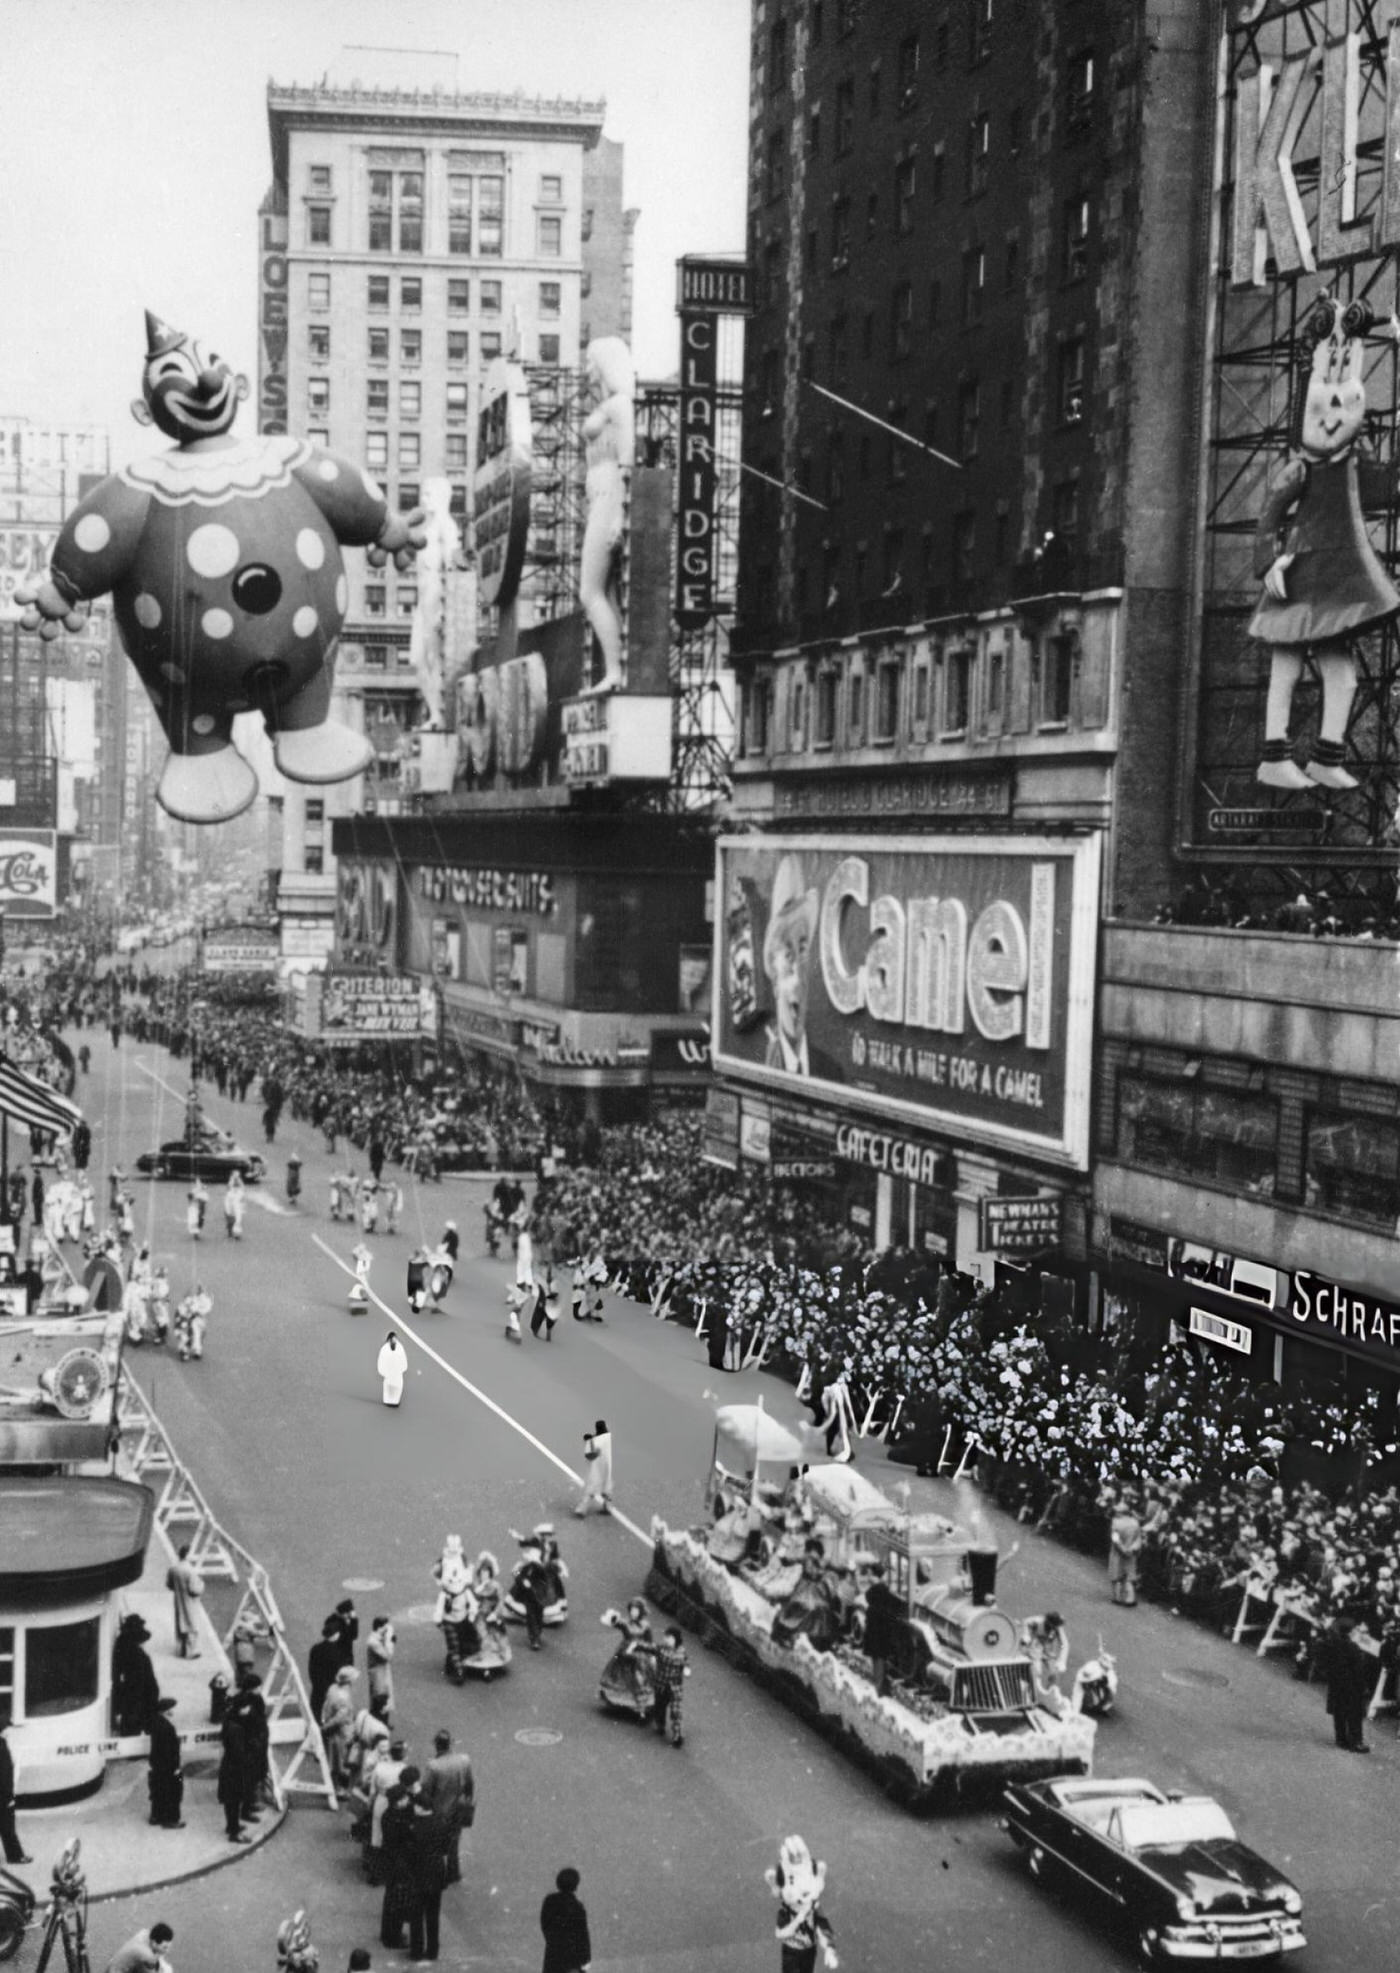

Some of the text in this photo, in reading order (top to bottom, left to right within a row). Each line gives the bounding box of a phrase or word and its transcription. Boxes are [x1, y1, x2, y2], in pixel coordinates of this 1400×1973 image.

[682, 321, 711, 611] CLARIDGE
[819, 856, 1056, 1050] Camel
[330, 976, 413, 994] CRITERION
[903, 1047, 915, 1077] A
[950, 1055, 978, 1094] FOR
[980, 1063, 993, 1098] A
[994, 1065, 1044, 1108] CAMEL
[837, 1124, 938, 1186] CAFETERIA
[57, 1743, 90, 1756] POLICE
